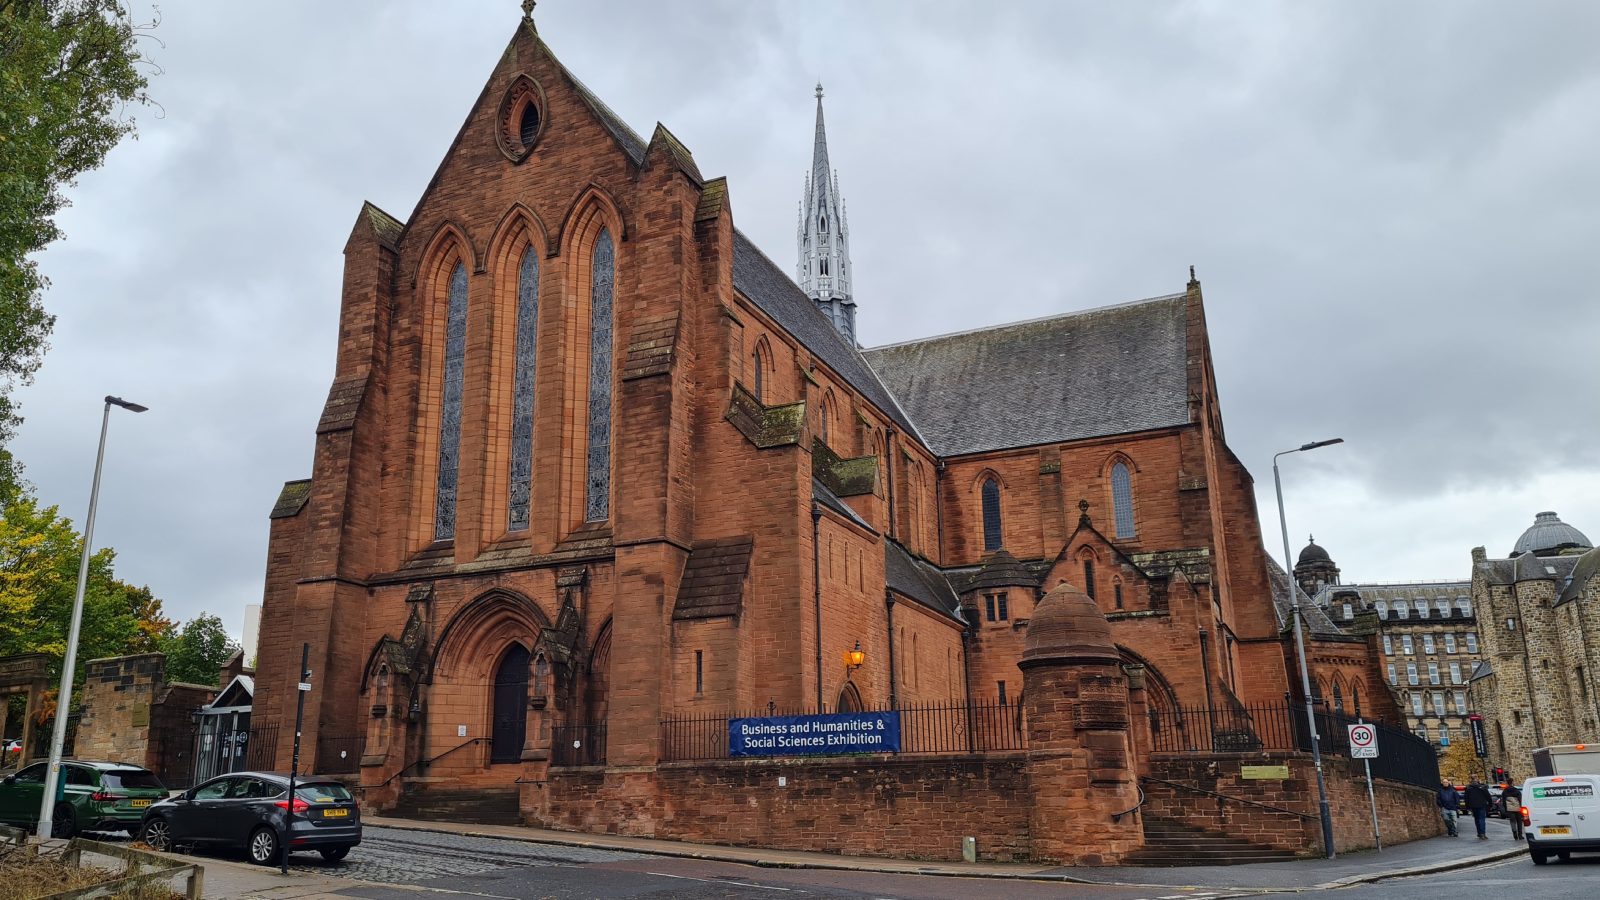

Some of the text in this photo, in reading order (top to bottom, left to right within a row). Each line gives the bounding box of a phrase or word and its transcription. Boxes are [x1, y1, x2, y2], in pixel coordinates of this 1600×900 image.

[741, 719, 885, 735] Business and Humanities &
[744, 733, 882, 748] Social Sciences Exhibition
[1354, 731, 1369, 741] 30
[1533, 787, 1592, 796] enterprise
